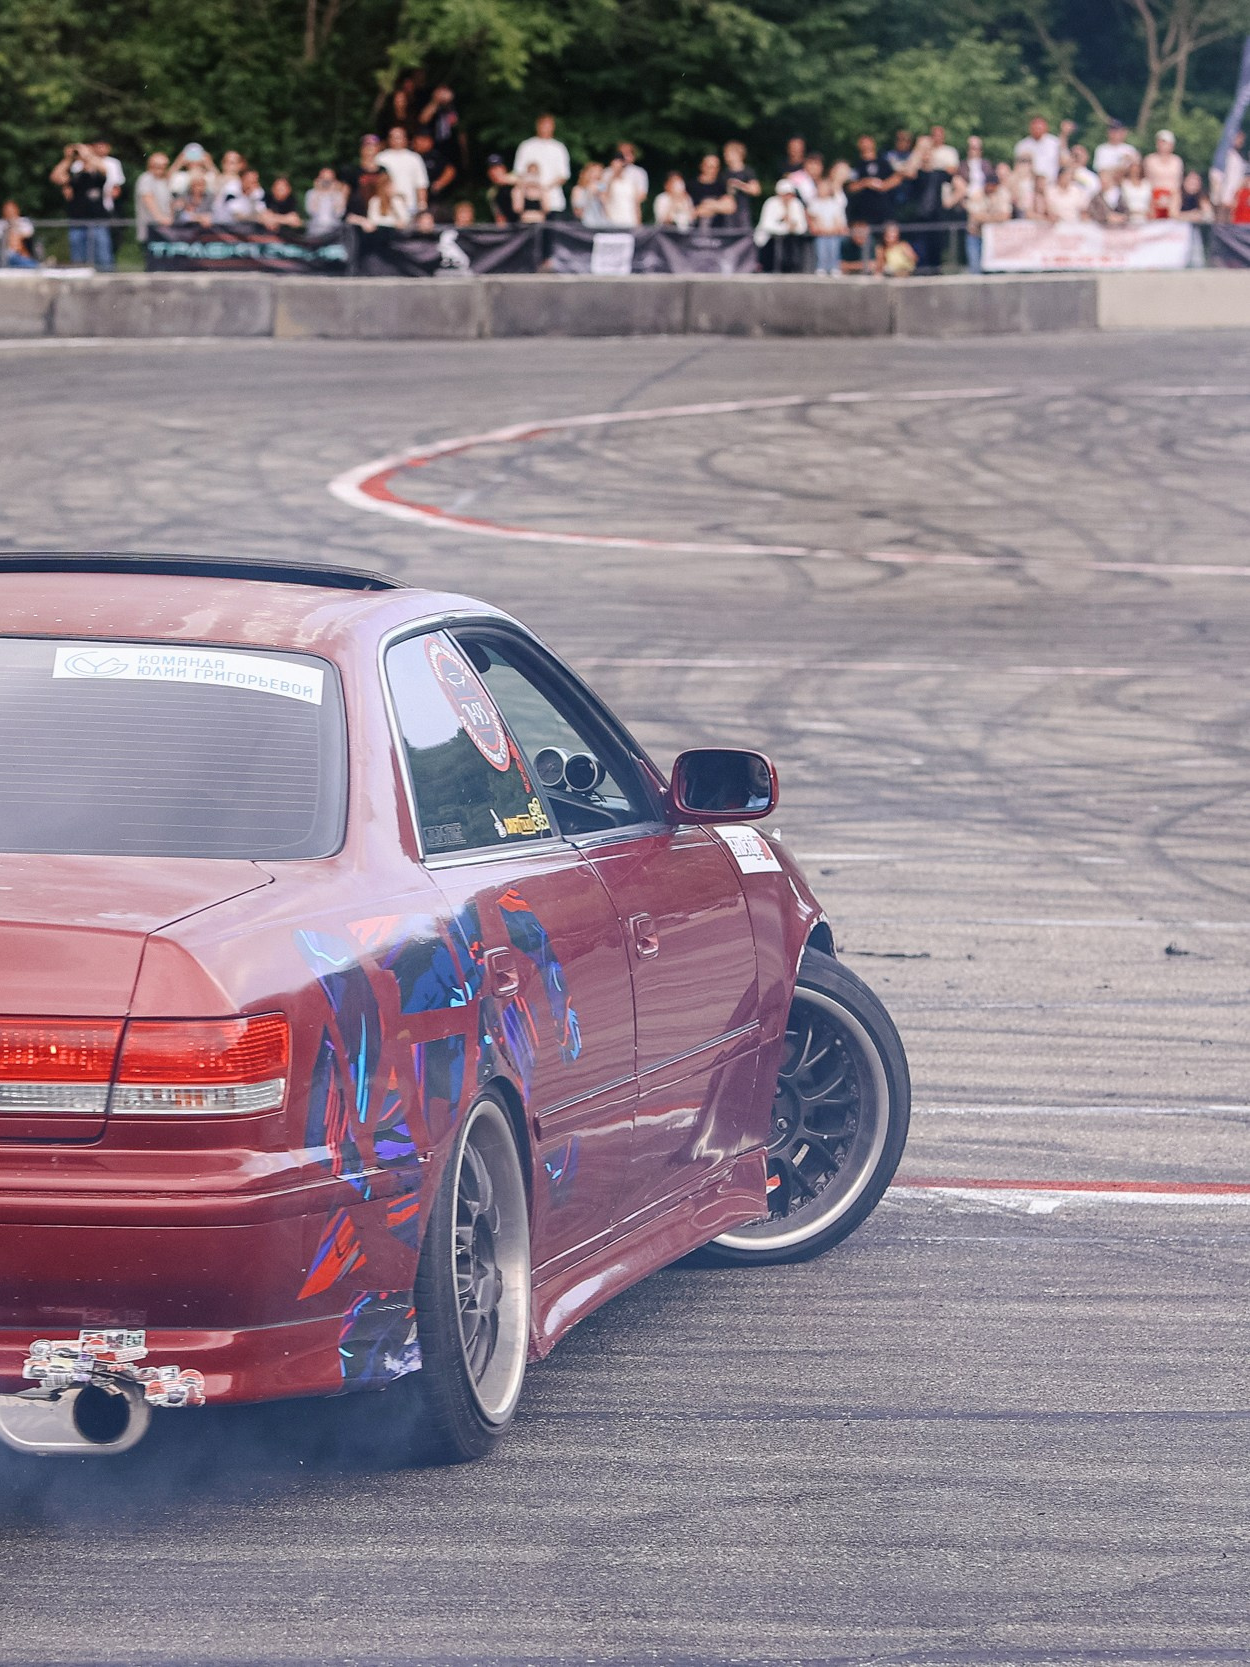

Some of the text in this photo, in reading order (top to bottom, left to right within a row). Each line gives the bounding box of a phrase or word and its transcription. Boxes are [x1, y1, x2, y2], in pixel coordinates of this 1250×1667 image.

[138, 655, 225, 670] КОМАНДА
[137, 665, 313, 699] ЮЛИИ ГРИГОРЬЕВОЙ
